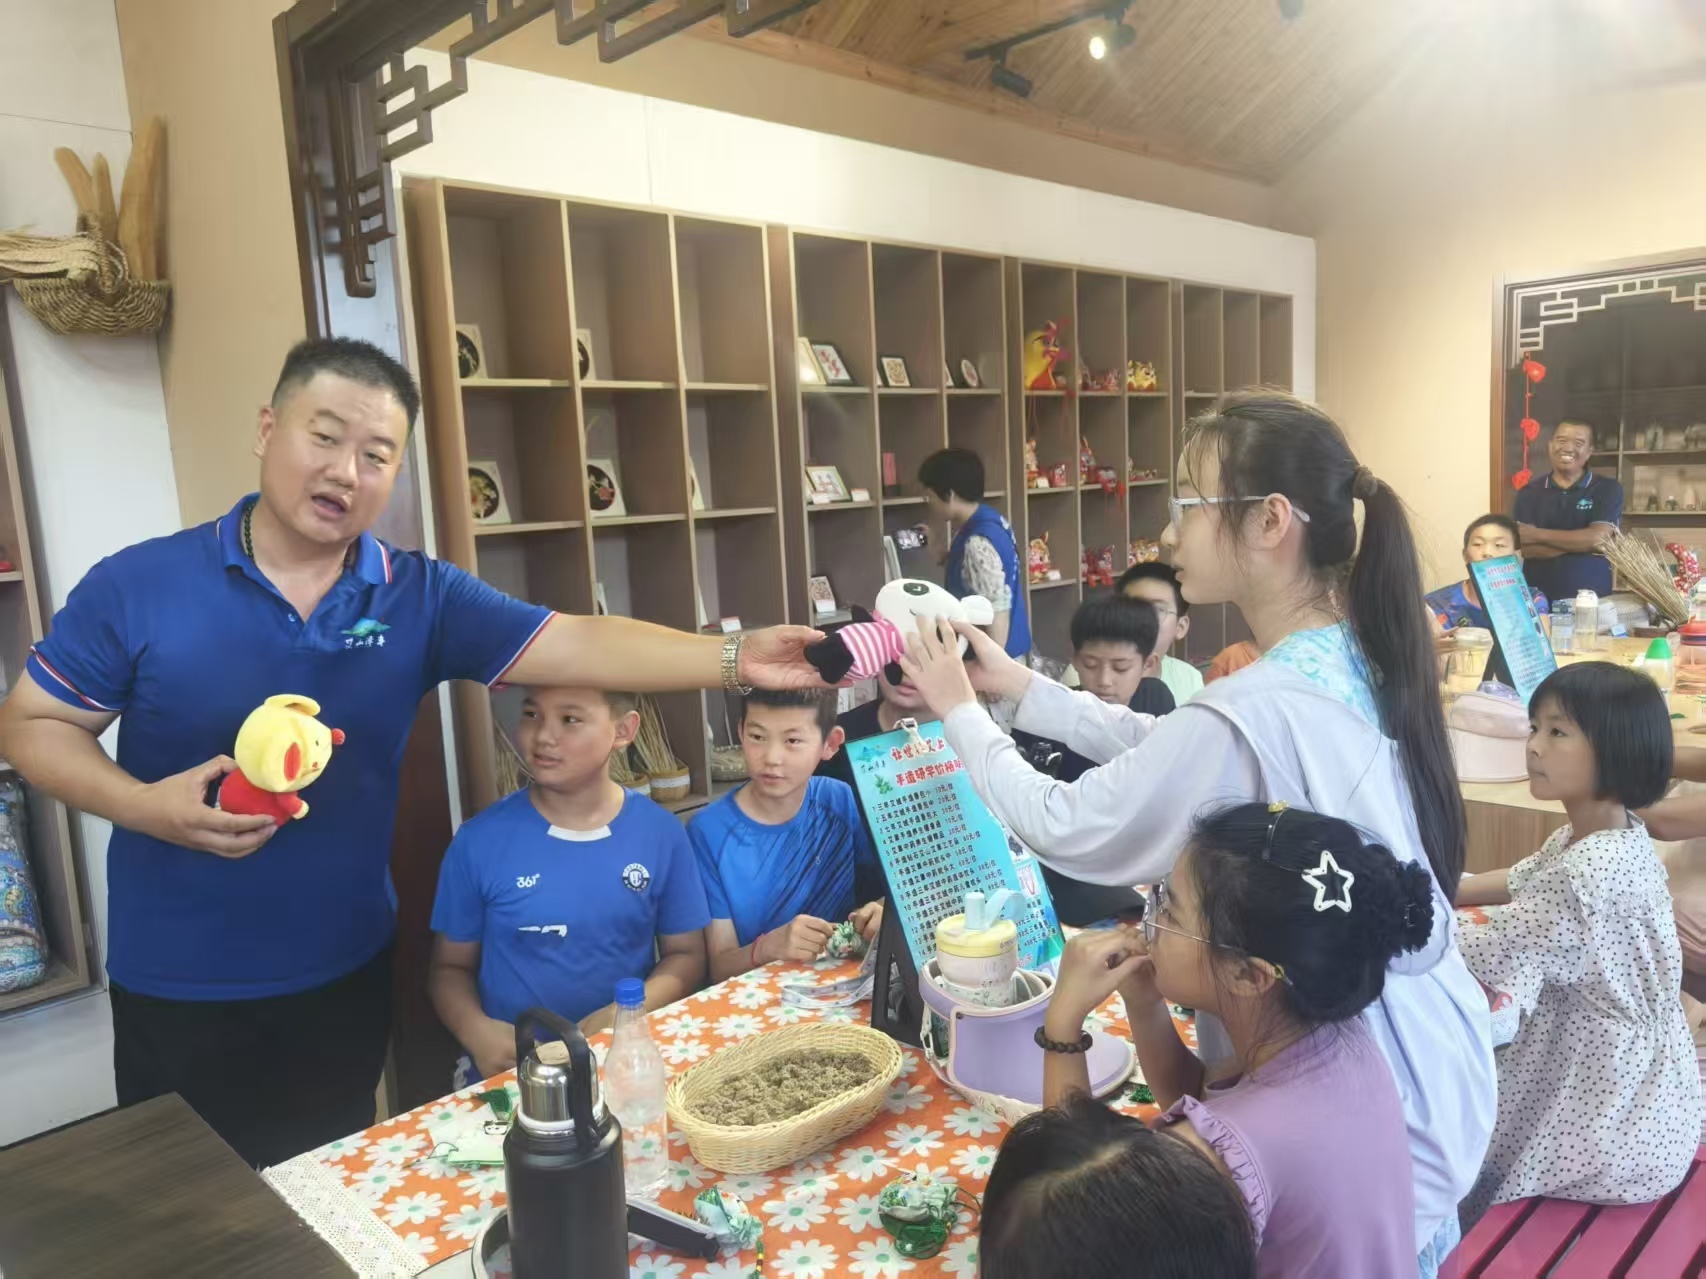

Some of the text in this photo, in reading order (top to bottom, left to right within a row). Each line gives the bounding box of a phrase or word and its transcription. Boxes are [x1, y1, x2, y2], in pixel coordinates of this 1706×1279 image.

[895, 758, 964, 786] 手造研学价格明
